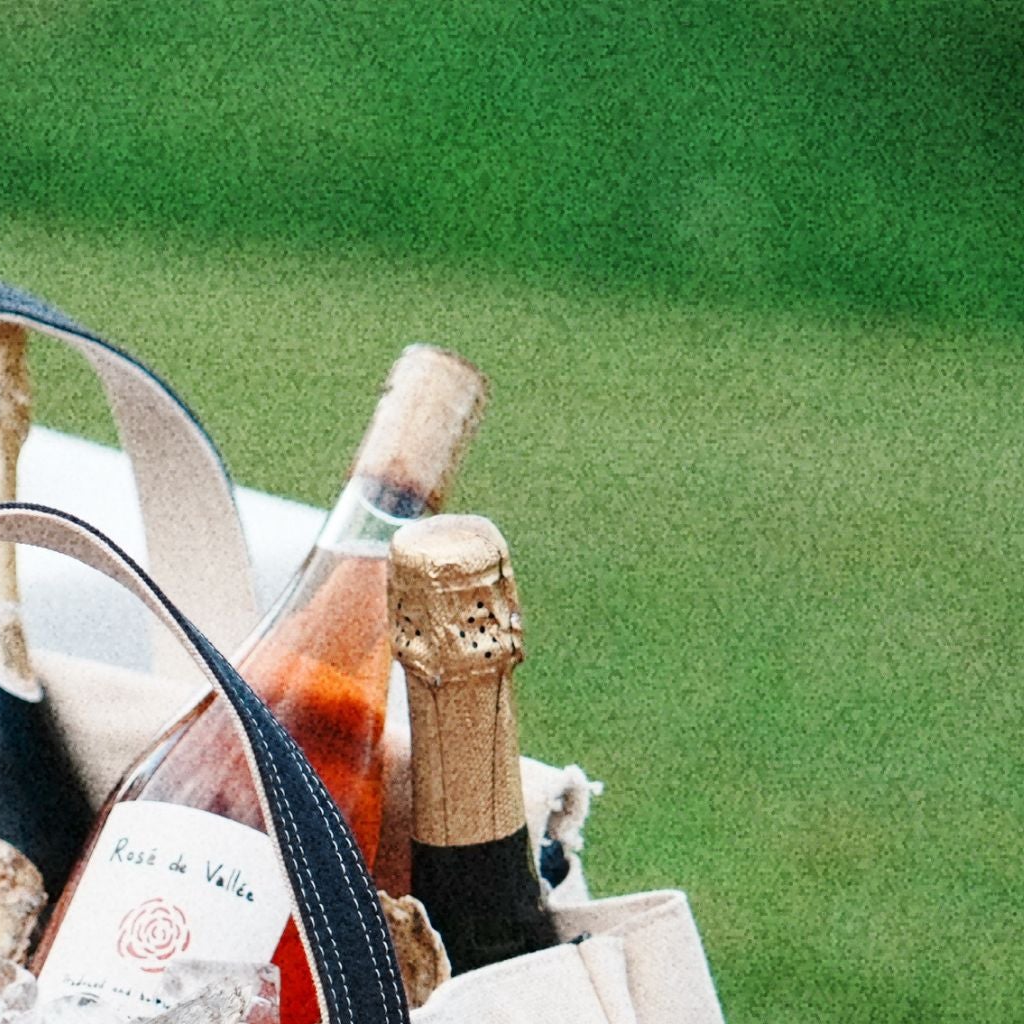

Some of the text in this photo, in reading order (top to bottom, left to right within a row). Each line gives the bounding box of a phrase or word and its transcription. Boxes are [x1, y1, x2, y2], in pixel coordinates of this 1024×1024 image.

[109, 837, 254, 902] Rosé de Vallée
